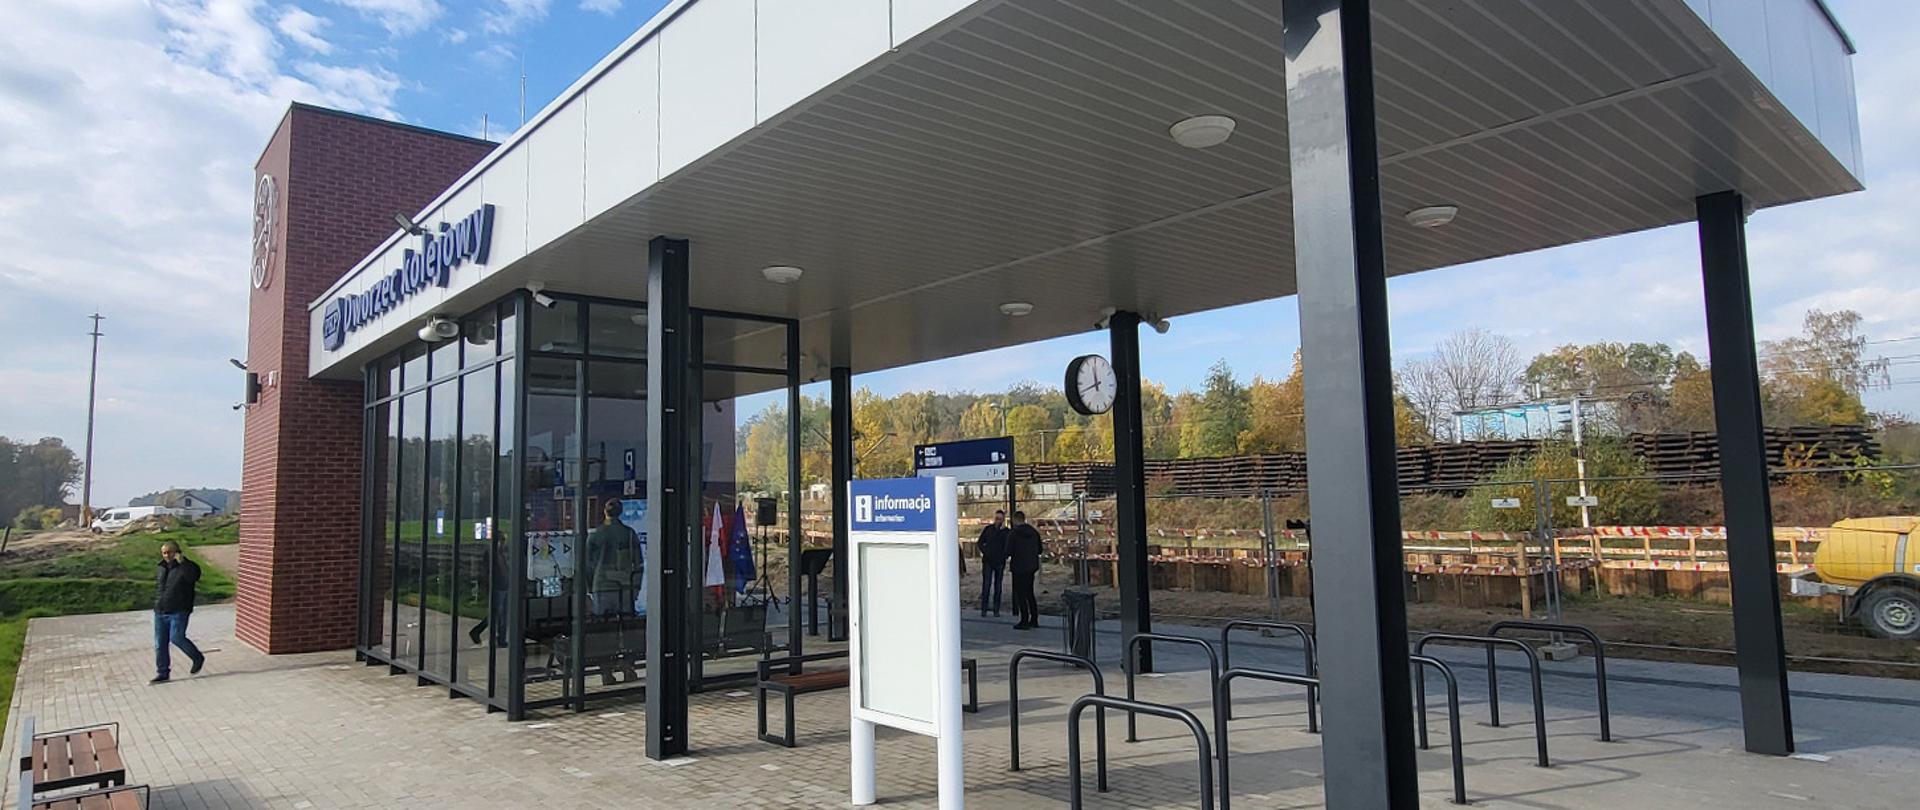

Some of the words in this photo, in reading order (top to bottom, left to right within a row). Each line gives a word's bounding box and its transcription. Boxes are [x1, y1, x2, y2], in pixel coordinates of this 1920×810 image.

[342, 267, 404, 333] Dworzec
[402, 203, 495, 297] kolejowy
[874, 494, 931, 513] informacja
